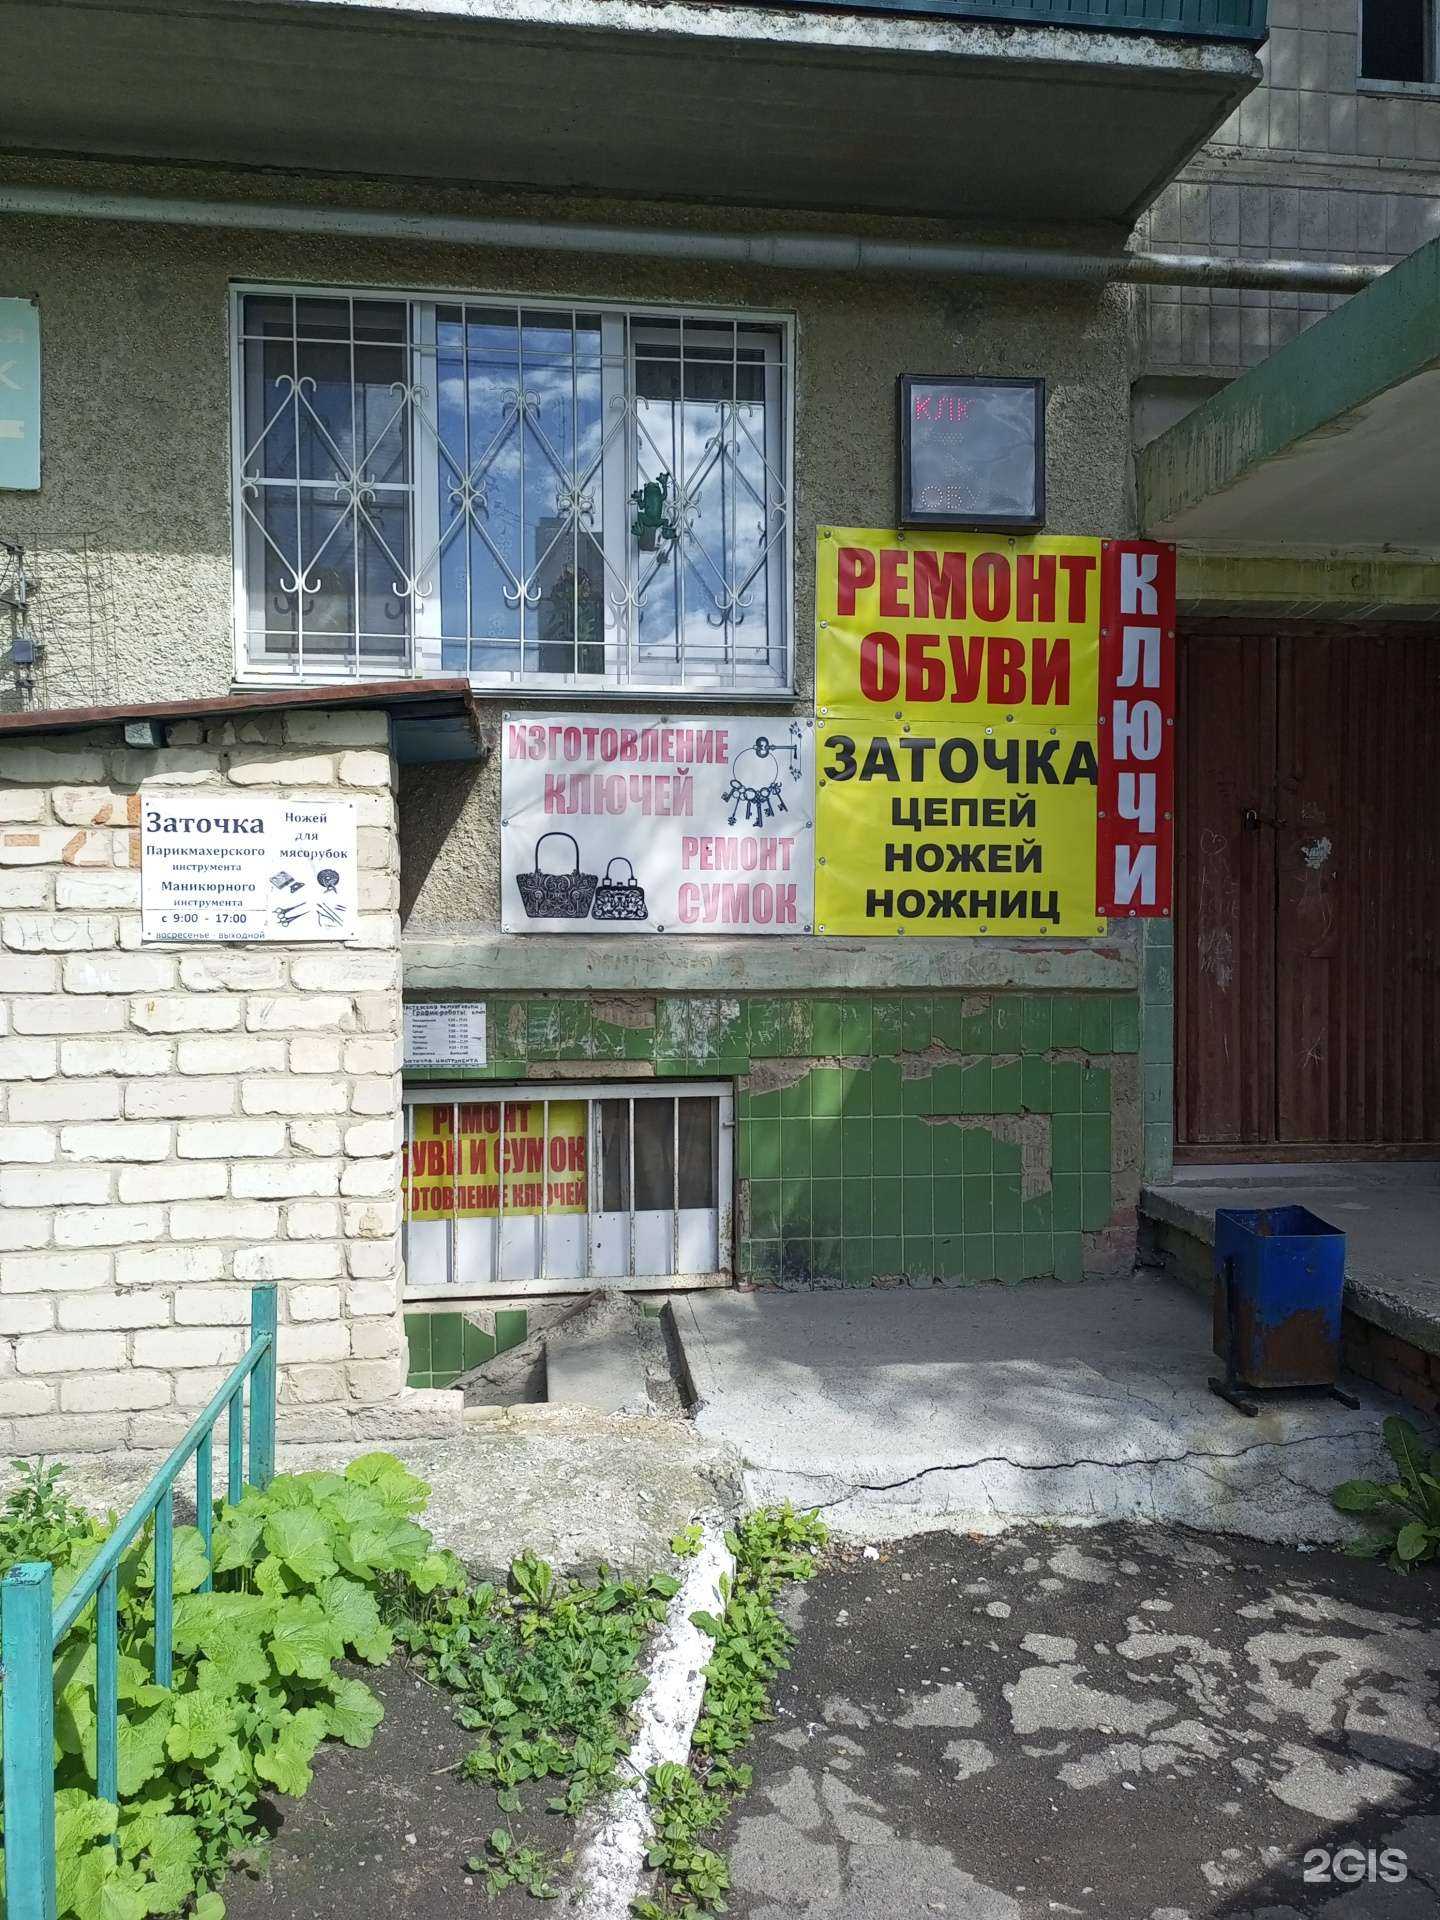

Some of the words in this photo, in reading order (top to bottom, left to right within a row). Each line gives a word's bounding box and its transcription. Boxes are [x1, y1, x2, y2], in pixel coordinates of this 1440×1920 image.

[837, 548, 1097, 623] РЕМОНТ
[859, 631, 1071, 706] ОБУВИ
[508, 725, 729, 765] ИЗГОТОВЛЕНИЕ
[1113, 552, 1163, 906] КЛЮЧИ
[823, 736, 1097, 787] ЗАТОЧКА
[544, 767, 694, 817] КЛЮЧЕЙ
[146, 812, 265, 834] Заточка
[285, 812, 328, 824] Ножей
[892, 792, 1037, 832] ЦЕПЕЙ
[146, 845, 266, 859] Парикмахерского
[295, 831, 319, 842] для
[682, 836, 795, 871] РЕМОНТ
[172, 864, 242, 873] инструмента
[279, 849, 348, 861] мясорубок
[884, 838, 1042, 874] НОЖЕЙ
[161, 881, 256, 893] Маникюрного
[173, 899, 243, 909] инструмента
[677, 882, 798, 925] СУМОК
[173, 914, 198, 923] 9:00
[215, 914, 247, 923] 17:00
[865, 889, 1061, 924] НОЖНИЦ
[469, 1138, 487, 1174] И
[493, 1135, 585, 1175] СУМОК
[512, 1177, 585, 1208] КЛЮЧЕЙ
